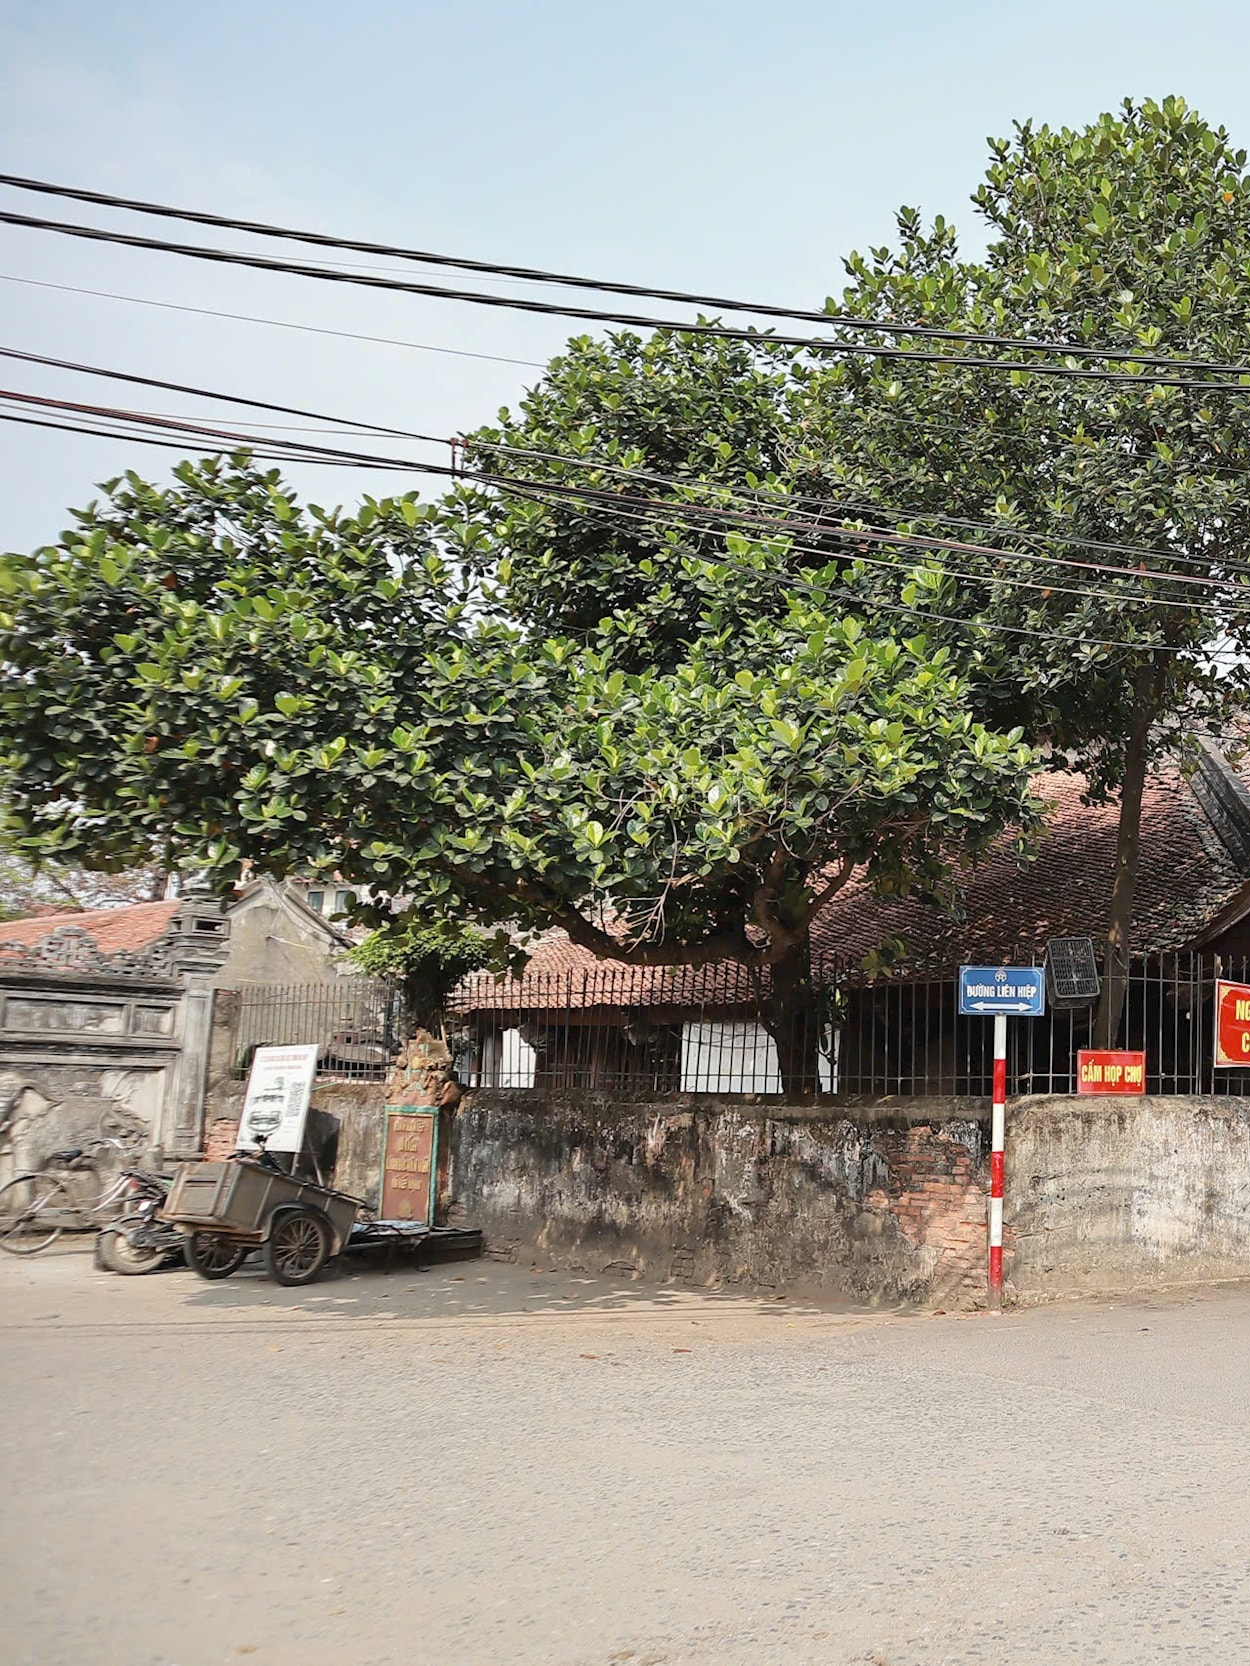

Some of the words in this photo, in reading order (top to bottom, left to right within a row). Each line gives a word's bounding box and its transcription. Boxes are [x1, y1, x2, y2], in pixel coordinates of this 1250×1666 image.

[966, 983, 996, 998] ĐƯỜNG
[997, 984, 1016, 998] LIÊN
[1017, 984, 1036, 1000] HIỆP
[1082, 1058, 1102, 1082] CẤM
[1104, 1065, 1122, 1086] HỌP
[1124, 1065, 1142, 1086] CHỢ
